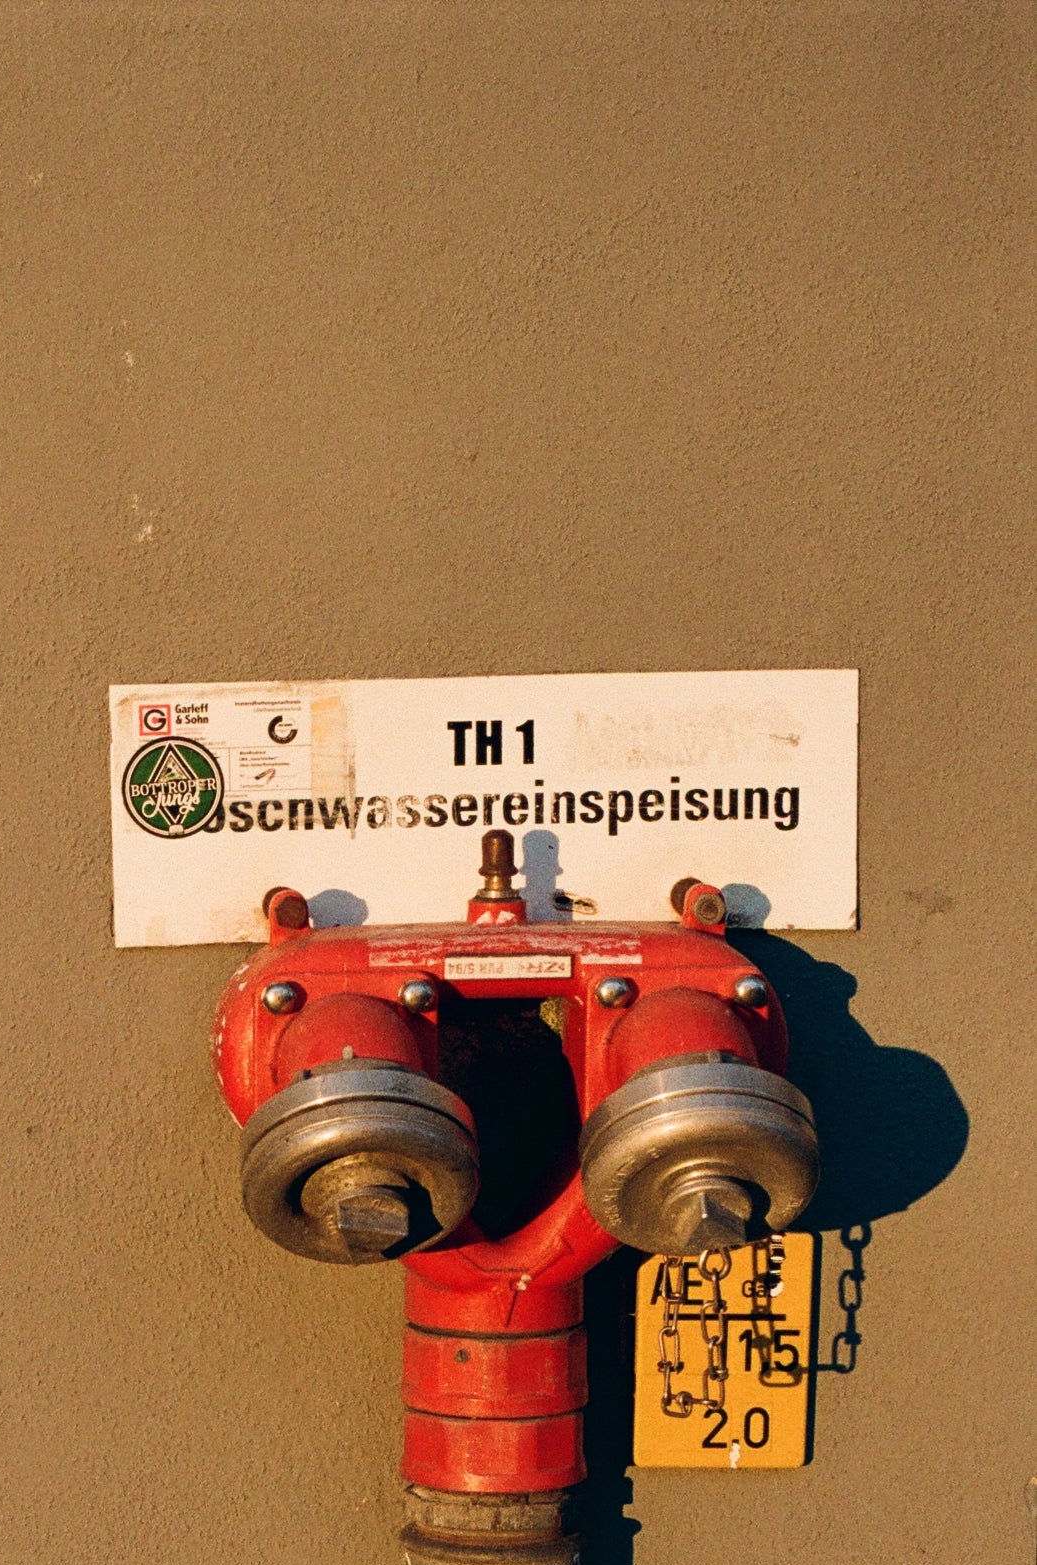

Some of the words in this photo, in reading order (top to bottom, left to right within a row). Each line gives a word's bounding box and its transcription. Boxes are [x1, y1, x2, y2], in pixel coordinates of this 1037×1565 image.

[175, 703, 209, 714] Garleff
[175, 715, 183, 725] &
[185, 715, 209, 725] Sohn
[447, 720, 503, 766] TH
[515, 719, 535, 765] 1
[130, 777, 218, 798] BOTTROPER
[141, 791, 201, 819] Jungs
[741, 1279, 780, 1298] Ga
